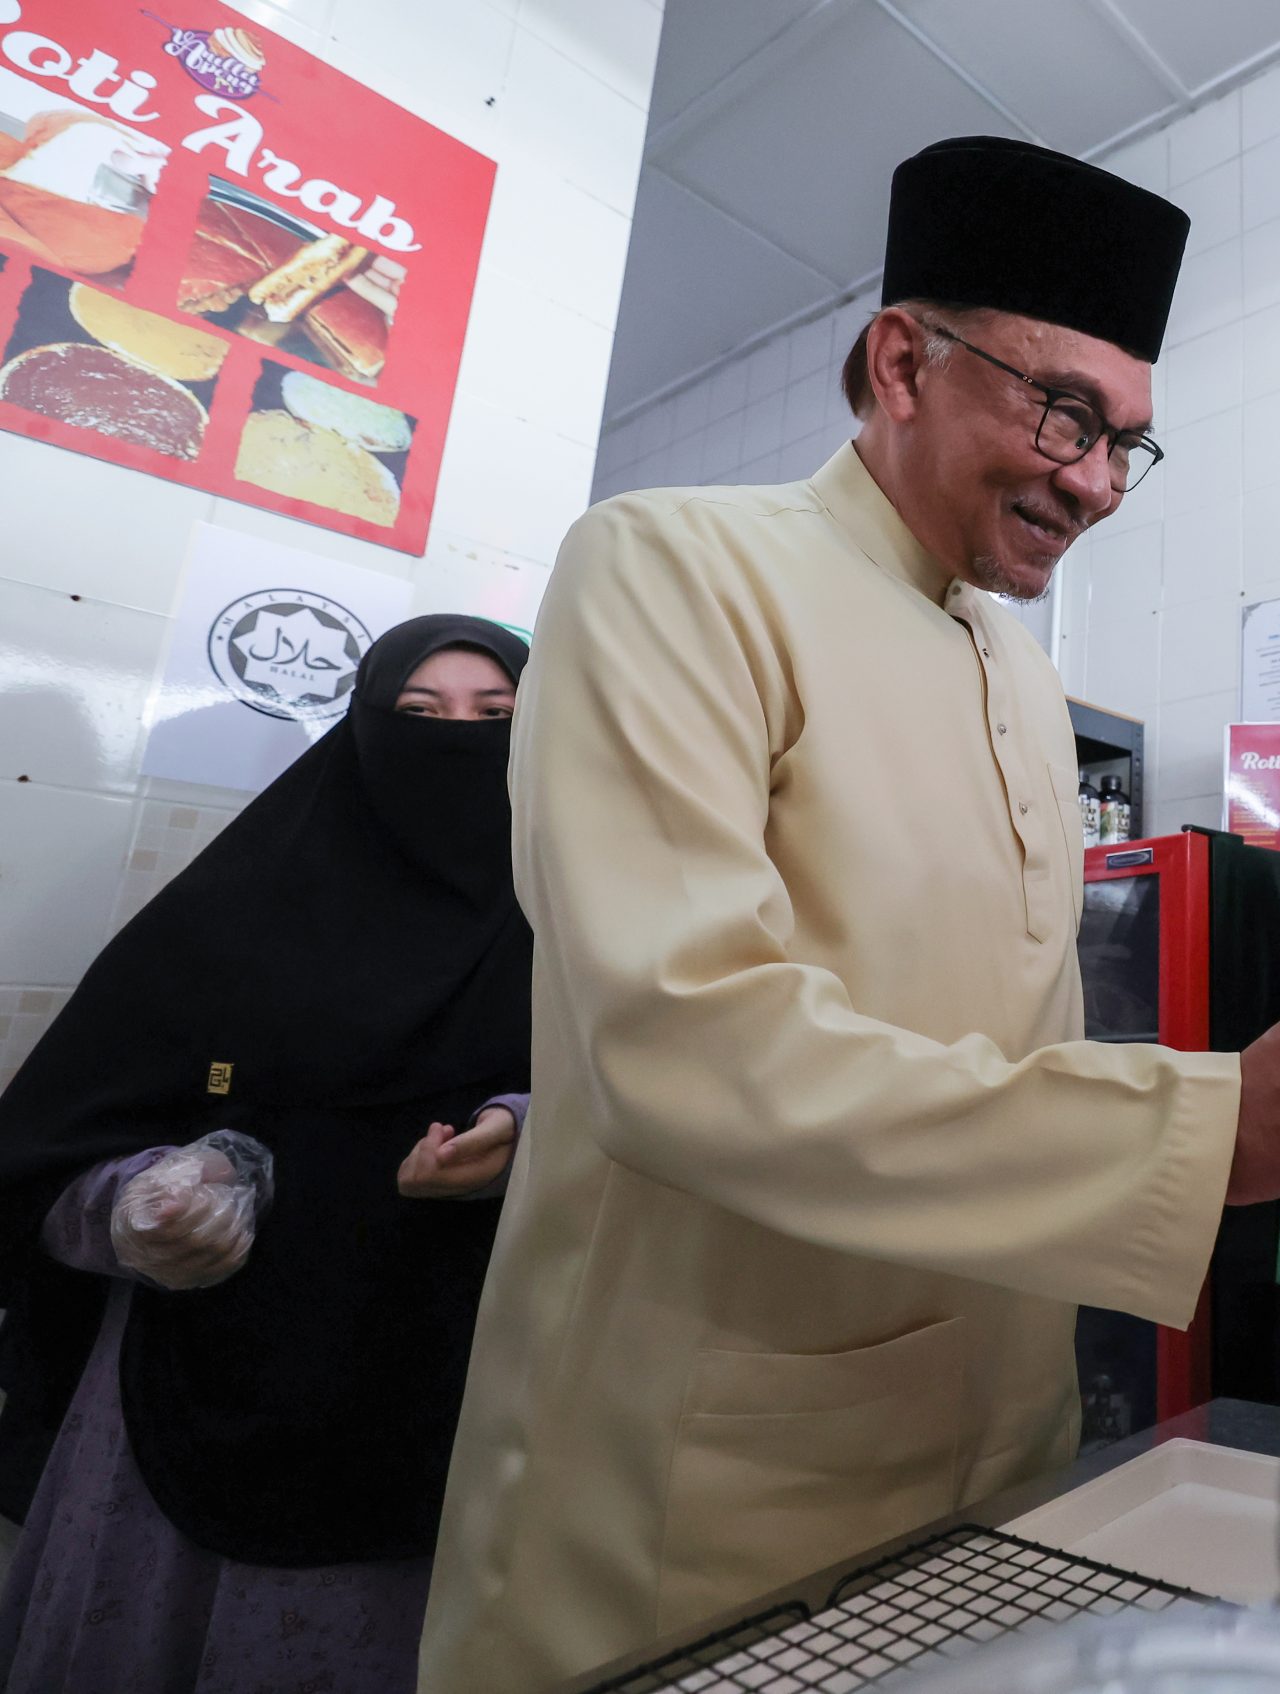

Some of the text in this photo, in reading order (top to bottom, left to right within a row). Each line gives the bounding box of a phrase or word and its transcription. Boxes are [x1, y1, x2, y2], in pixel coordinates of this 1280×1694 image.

[0, 0, 423, 252] oti Arab
[222, 594, 366, 640] MALAYSI
[248, 626, 342, 671] حلال
[269, 665, 315, 682] HALAL
